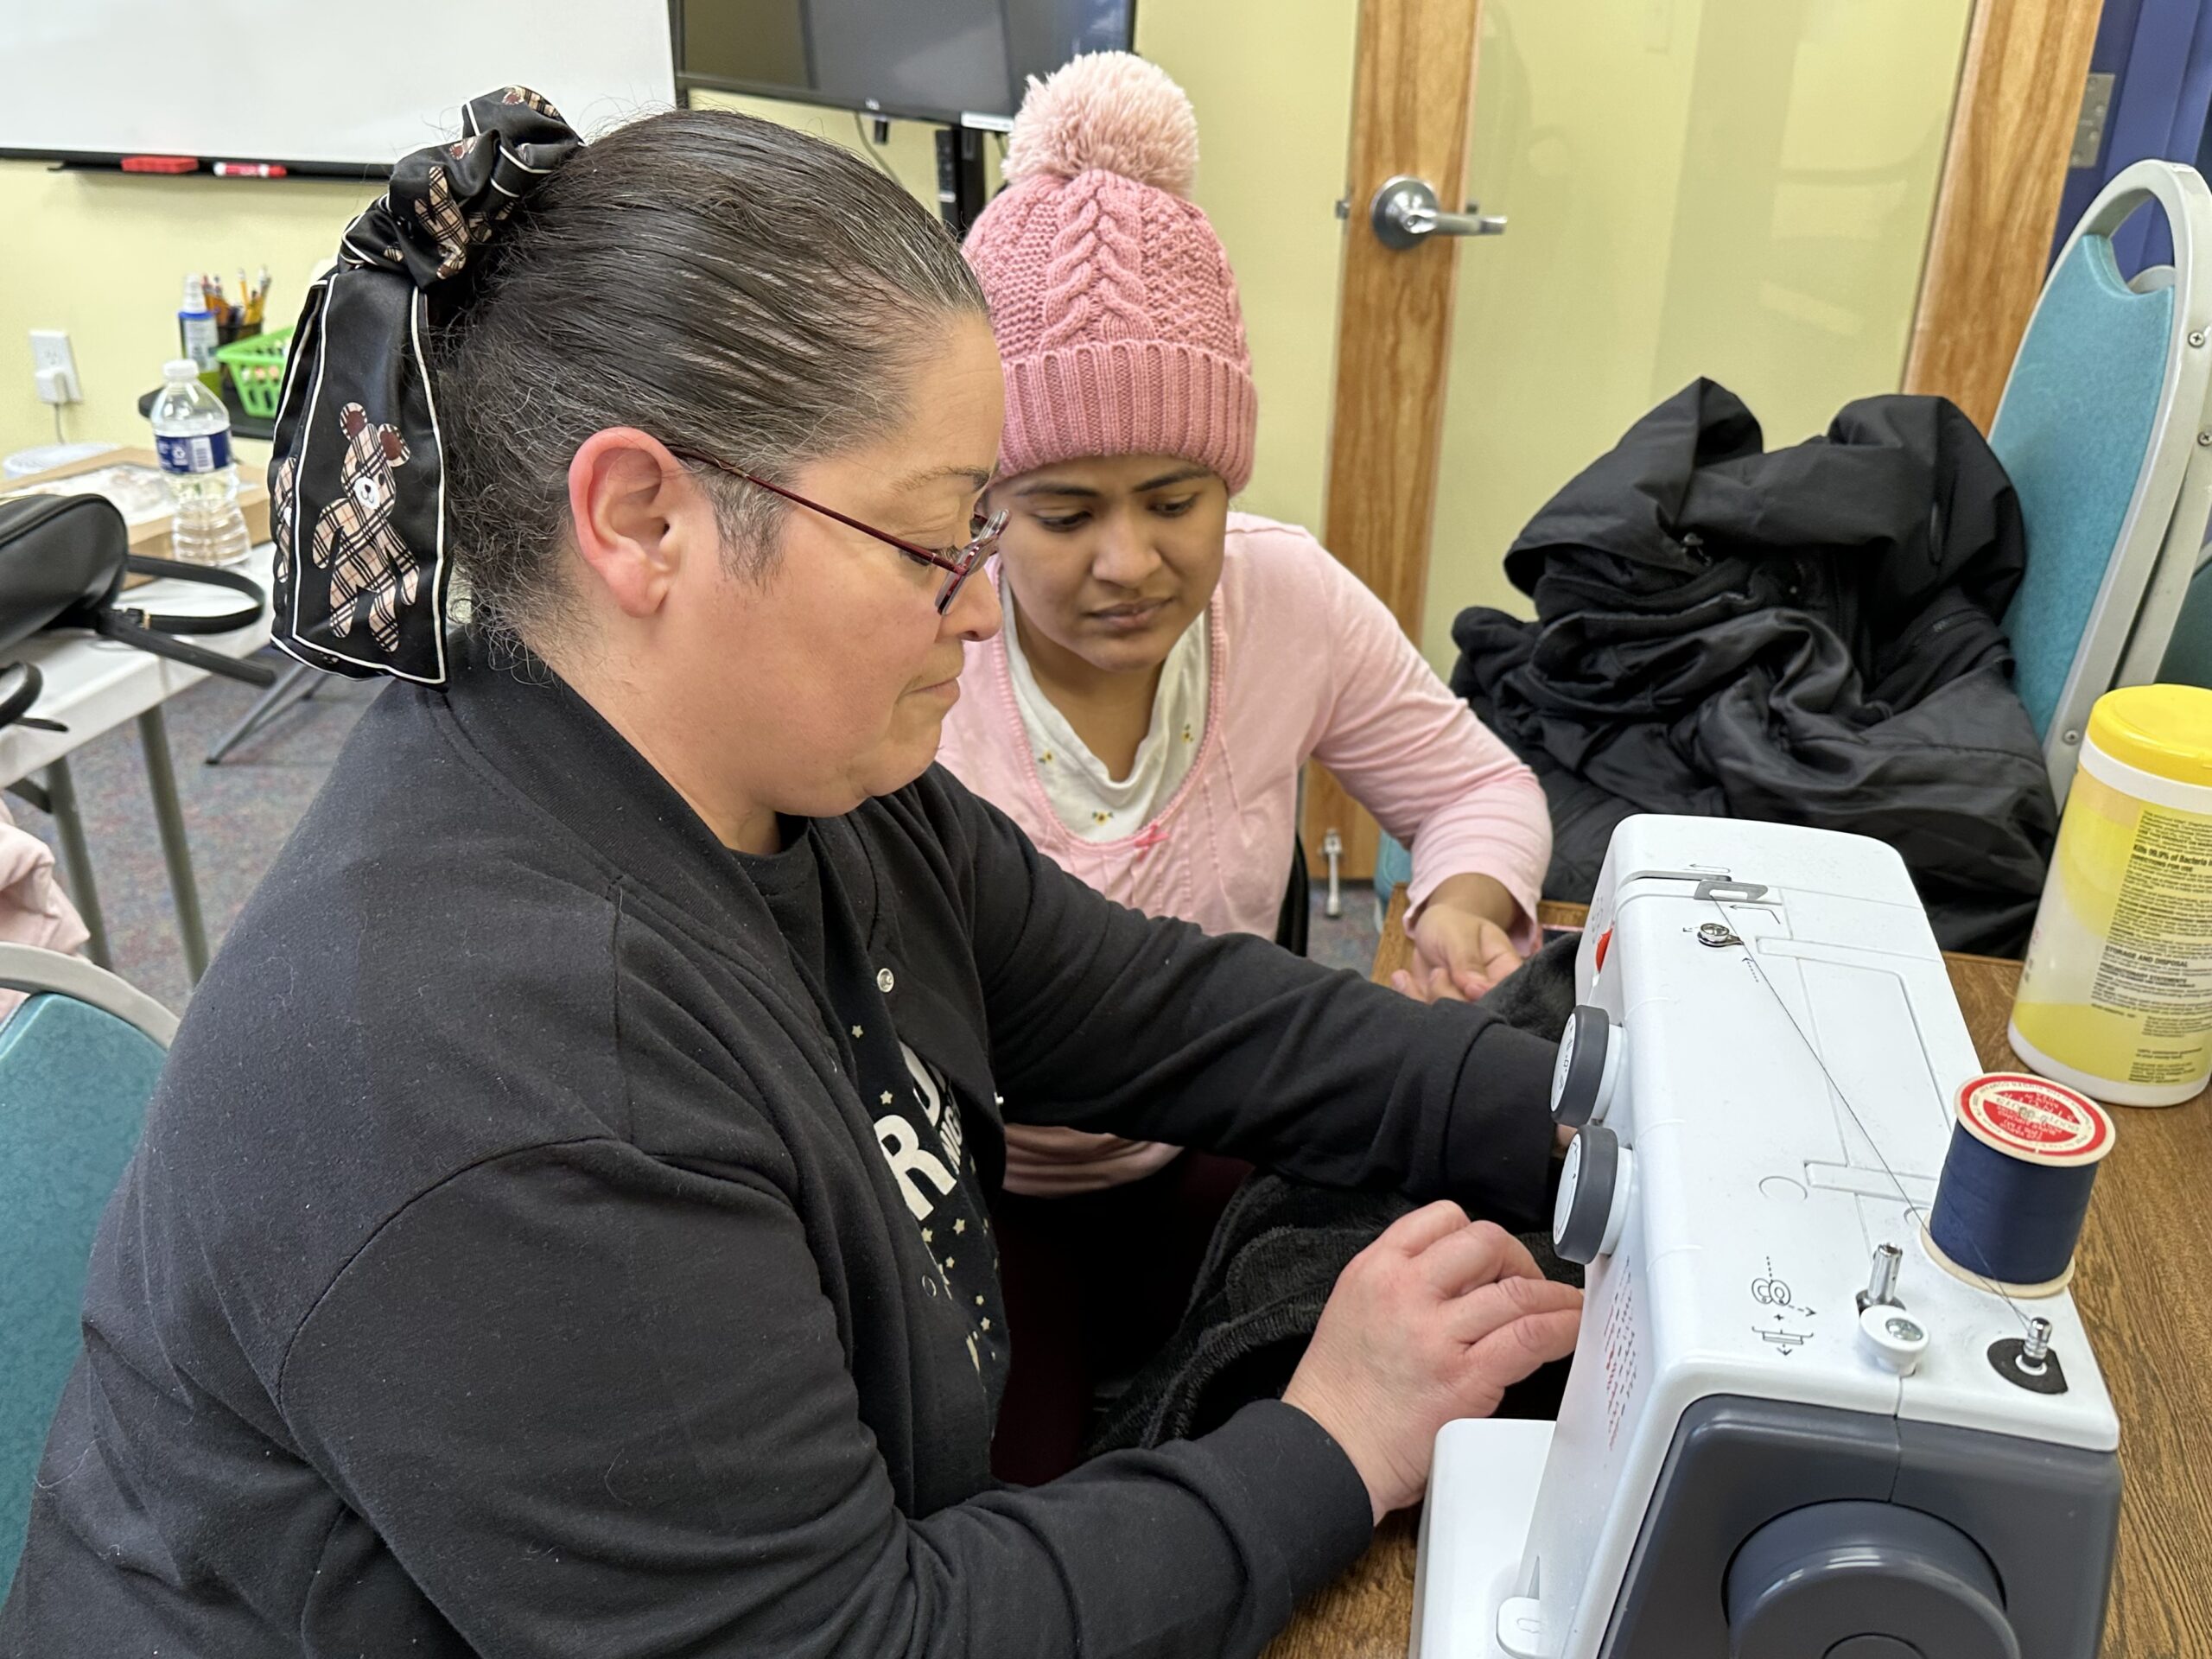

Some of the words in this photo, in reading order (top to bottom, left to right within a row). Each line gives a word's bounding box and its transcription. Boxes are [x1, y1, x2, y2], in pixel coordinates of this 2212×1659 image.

[2148, 849, 2170, 861] 99.9%
[2171, 854, 2179, 862] of
[2179, 855, 2208, 867] Bacteria
[2105, 945, 2137, 958] STORAGE
[2138, 954, 2153, 963] AND
[2154, 958, 2189, 968] DISPOSAL
